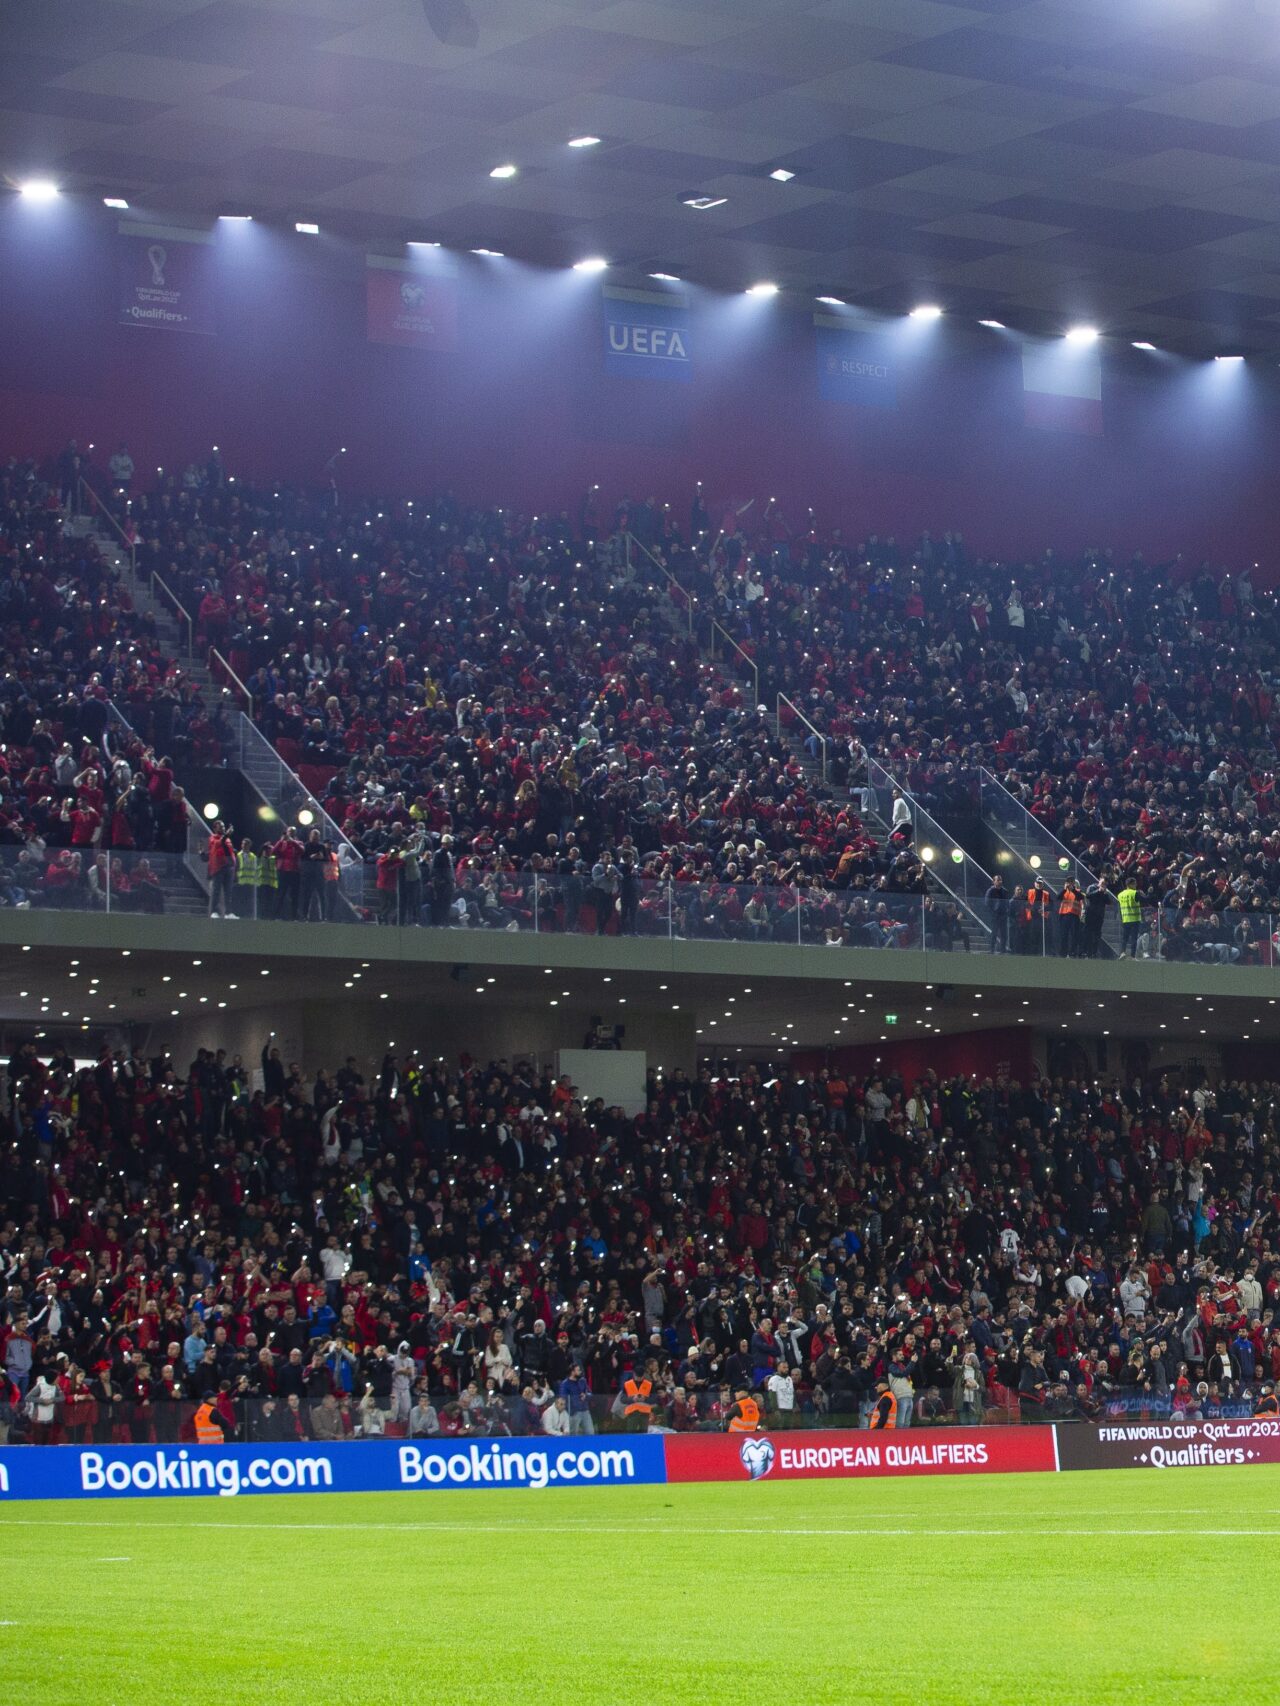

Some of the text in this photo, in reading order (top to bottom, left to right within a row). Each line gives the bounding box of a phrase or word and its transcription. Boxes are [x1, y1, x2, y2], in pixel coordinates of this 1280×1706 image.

[131, 306, 183, 322] Qualifiers
[609, 324, 686, 358] UEFA
[842, 361, 889, 378] RESPECT
[1099, 1427, 1127, 1442] FIFA
[1125, 1426, 1172, 1441] WORLD
[1174, 1425, 1198, 1439] CUP
[399, 1444, 635, 1489] Booking.com
[780, 1443, 989, 1469] EUROPEAN QUALIFIERS
[1150, 1443, 1245, 1469] Qualifiers
[81, 1450, 333, 1497] Booking.com
